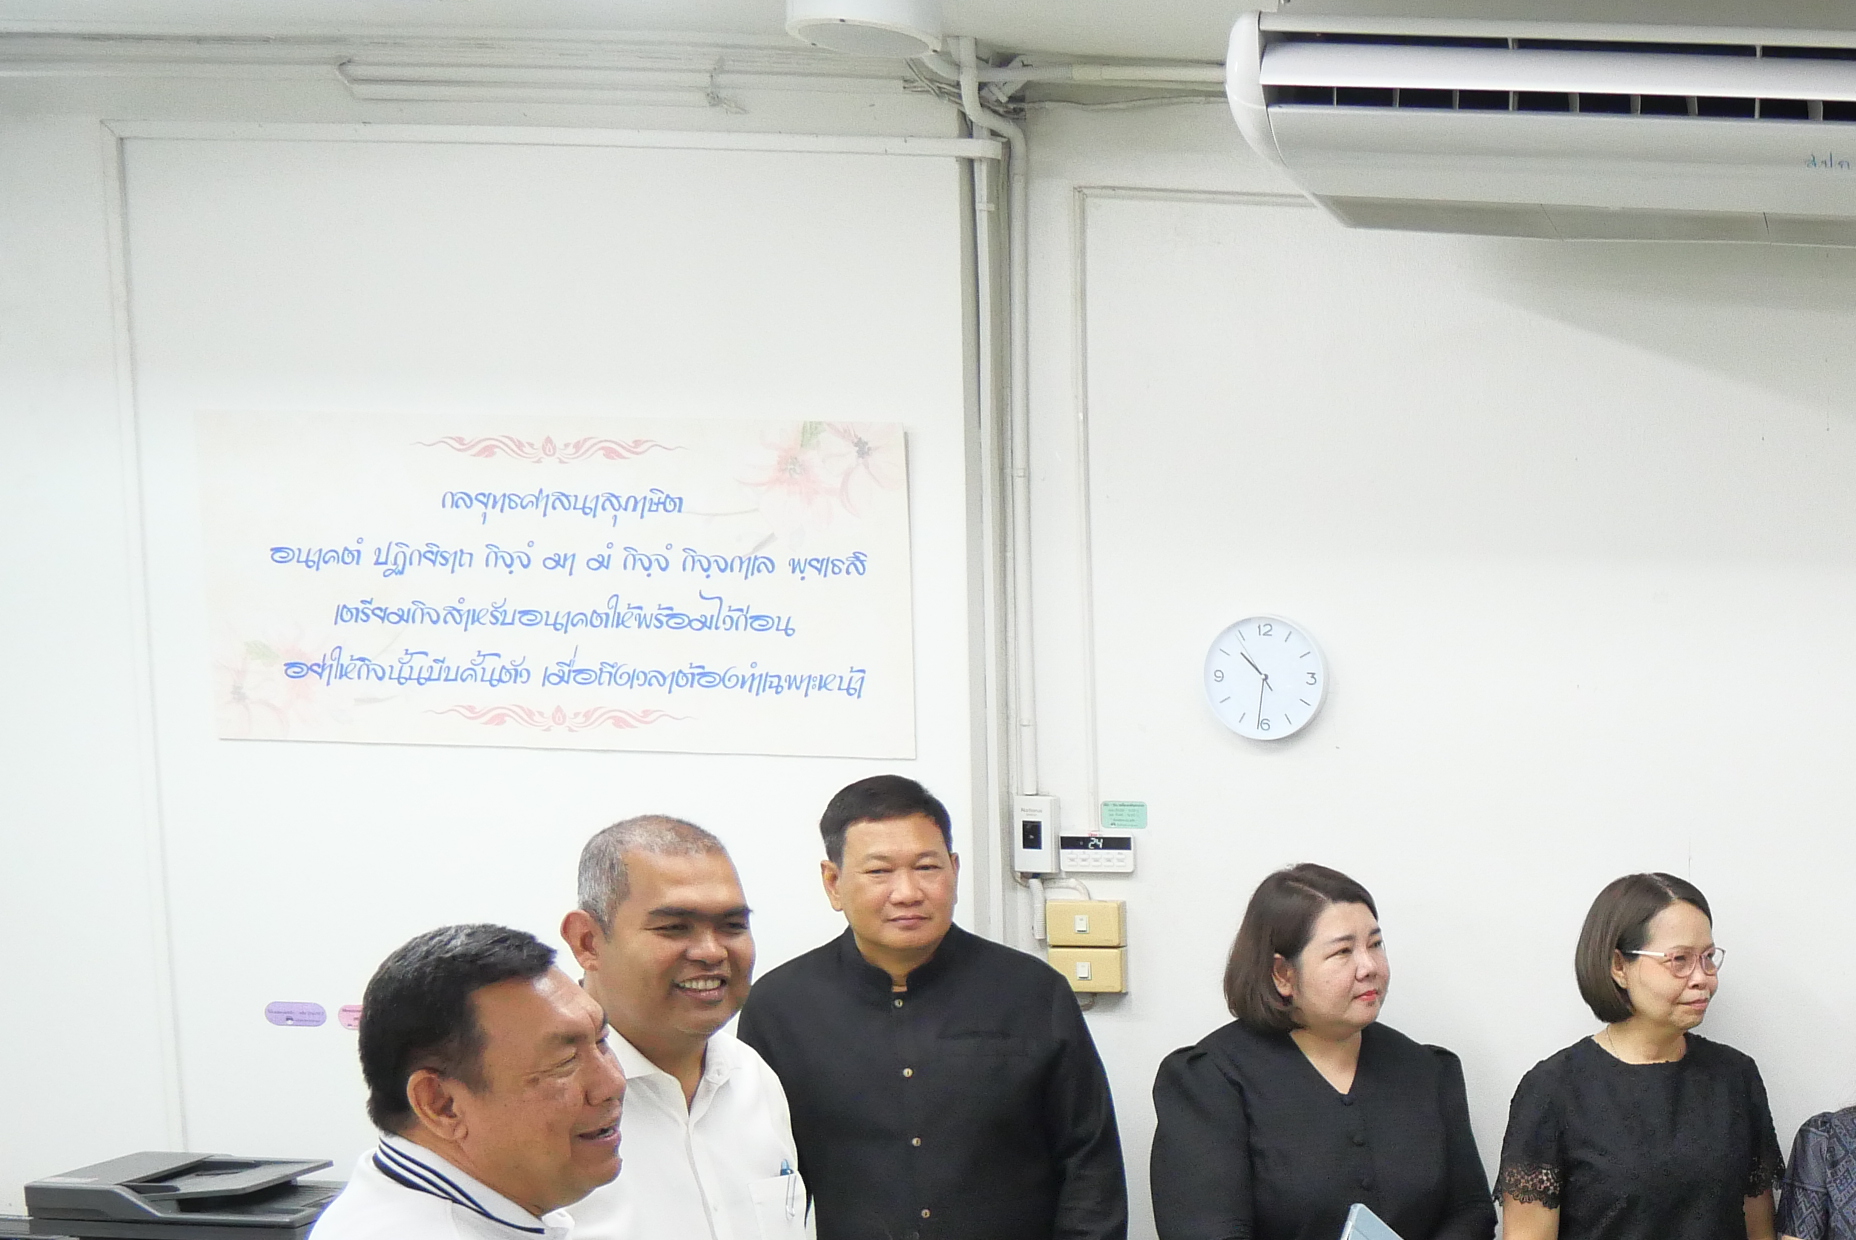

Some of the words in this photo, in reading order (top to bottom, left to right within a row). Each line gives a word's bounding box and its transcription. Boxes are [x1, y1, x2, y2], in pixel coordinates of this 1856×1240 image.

[1256, 623, 1274, 637] 12
[1213, 669, 1225, 683] 9
[1305, 671, 1317, 686] 3
[1259, 718, 1271, 732] 6
[1088, 837, 1104, 850] 24
